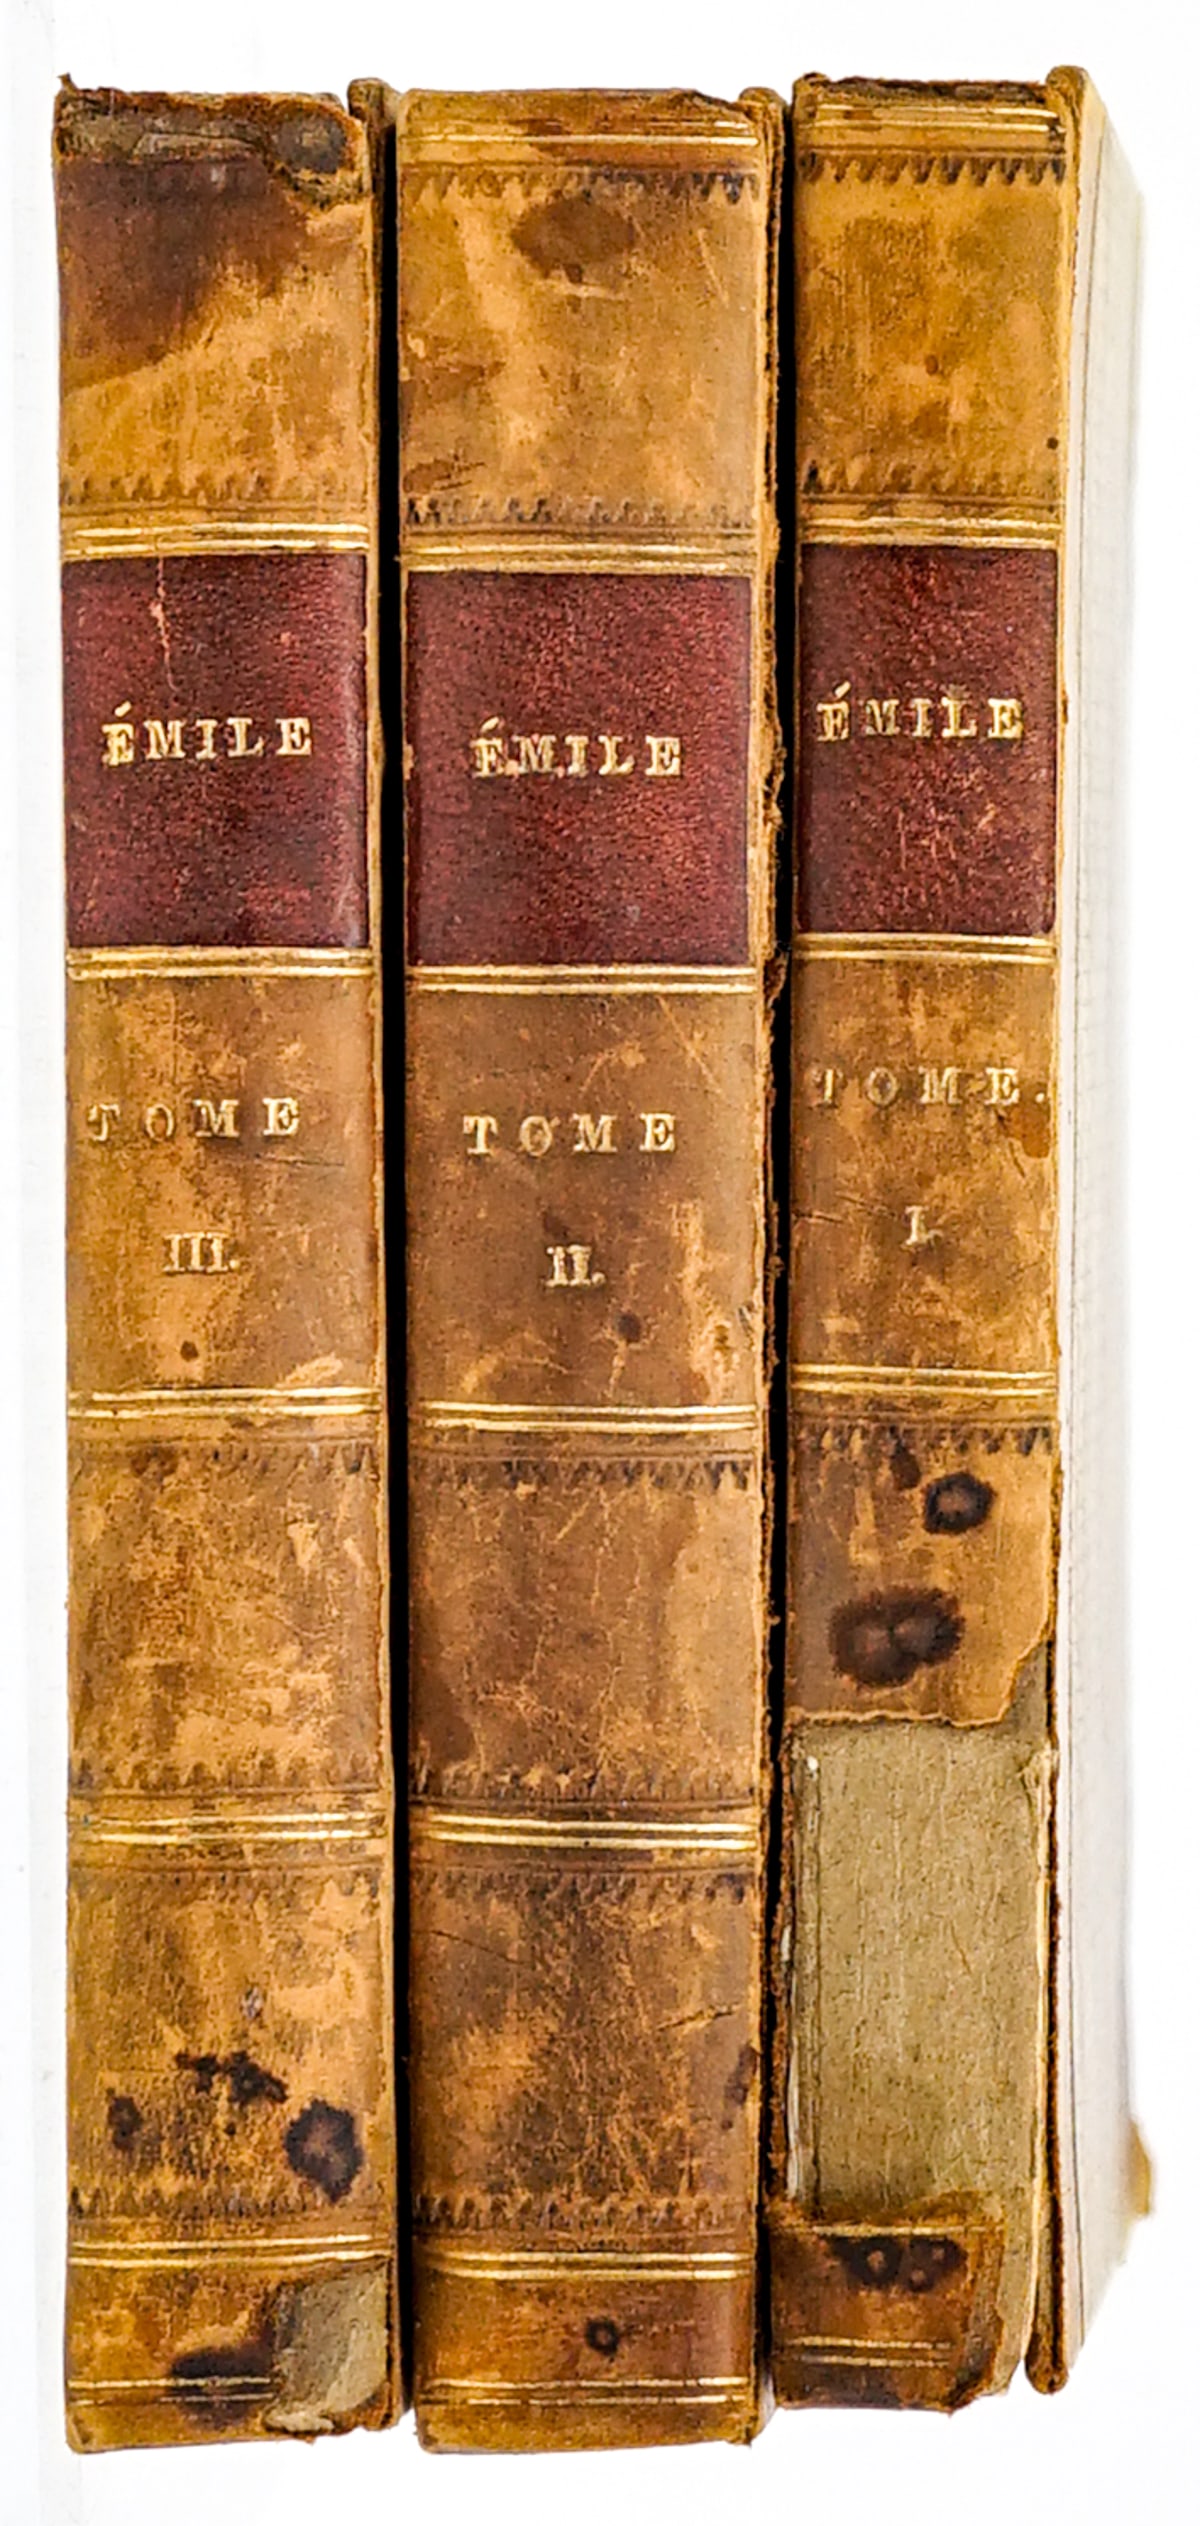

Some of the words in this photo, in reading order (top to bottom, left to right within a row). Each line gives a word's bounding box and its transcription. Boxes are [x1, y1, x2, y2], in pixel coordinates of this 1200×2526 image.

[101, 701, 312, 766] ÉMILE
[817, 682, 1023, 741] ÉMILE
[471, 716, 681, 777] ÉMILE
[88, 1096, 299, 1142] TOME
[463, 1113, 676, 1157] TOME
[163, 1231, 239, 1273] III.
[545, 1245, 605, 1287] II.
